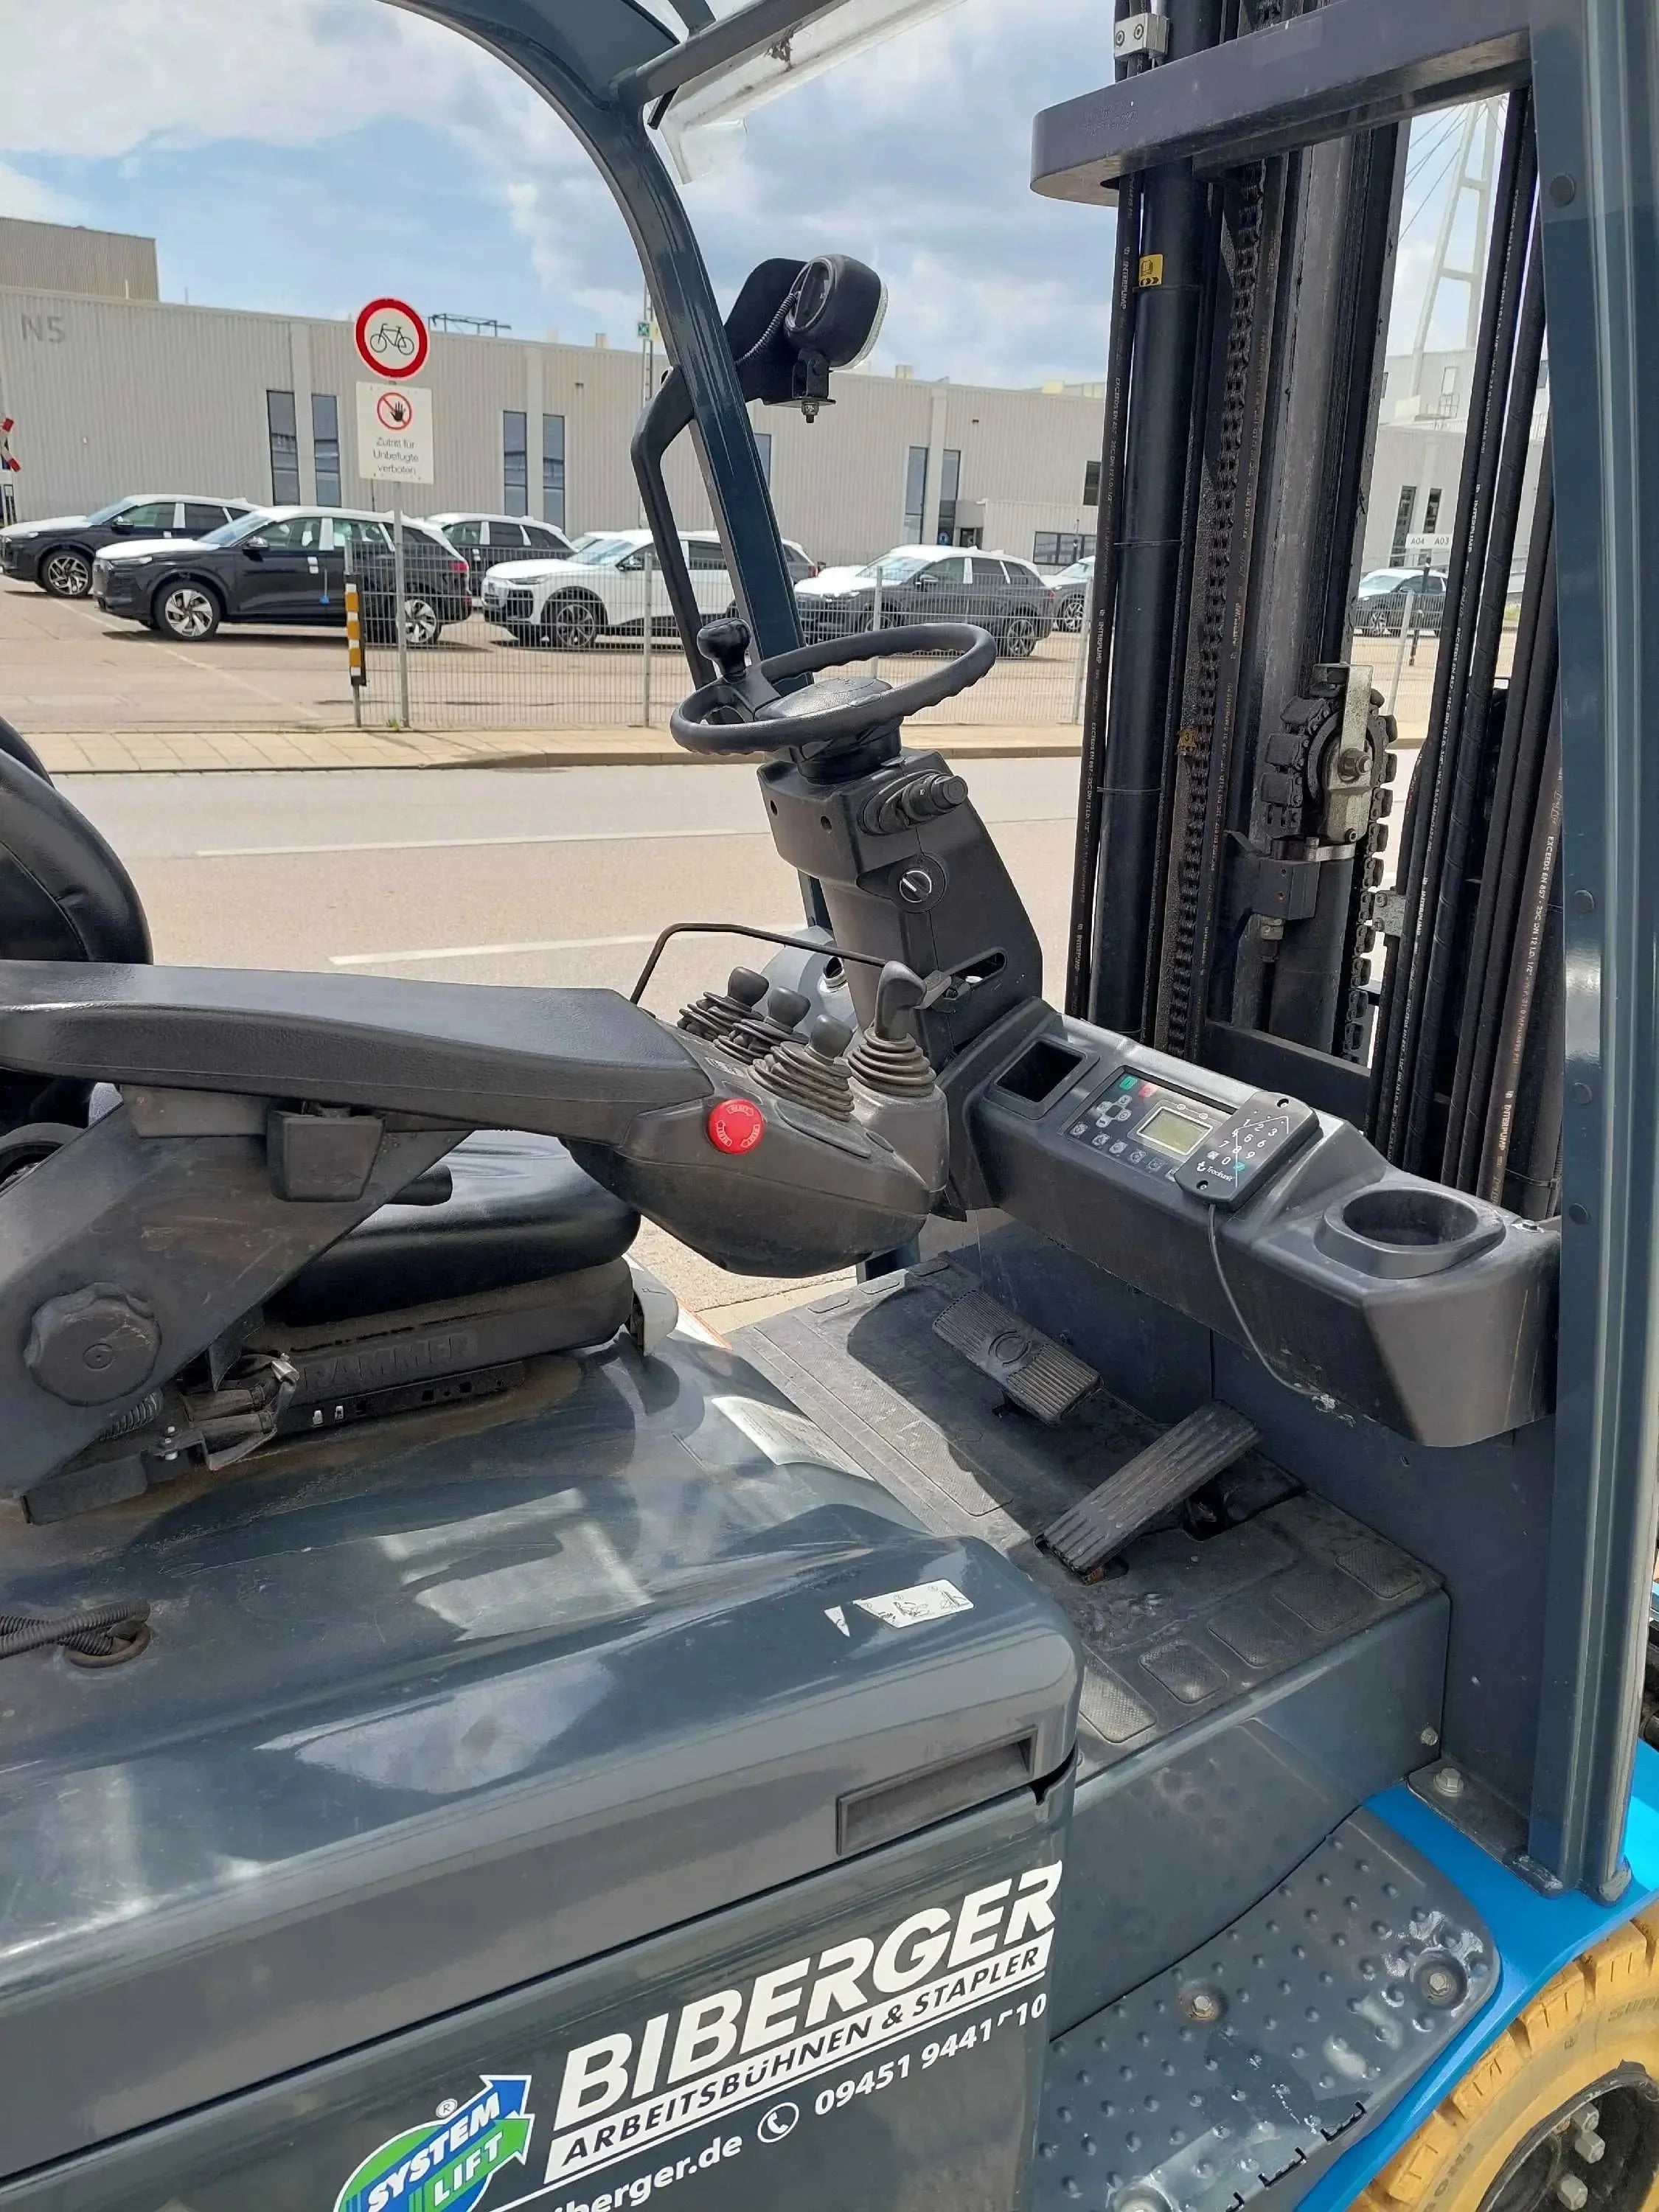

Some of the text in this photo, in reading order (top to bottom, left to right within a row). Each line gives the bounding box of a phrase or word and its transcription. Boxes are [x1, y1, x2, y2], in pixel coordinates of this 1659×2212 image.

[1118, 260, 1130, 310] INTERPUMP
[21, 313, 65, 344] N5
[1467, 499, 1478, 553] INTERPUMP
[1095, 621, 1105, 664] INTERPUMP
[1542, 835, 1554, 871] EXCEEDS
[1537, 884, 1547, 899] 857
[1539, 872, 1548, 883] EN
[1414, 890, 1427, 936] INTERPUMP
[1531, 922, 1541, 934] DN
[1533, 905, 1543, 921] 2SC
[1526, 946, 1537, 959] I.D.
[1529, 936, 1539, 945] 12
[1243, 1119, 1278, 1137] 1 2 3
[1244, 1133, 1254, 1143] 5
[1256, 1139, 1267, 1148] 6
[1498, 1104, 1512, 1151] INTERPUMP
[1219, 1140, 1231, 1148] 7
[1245, 1151, 1256, 1159] 9
[303, 1331, 474, 1392] RAMMER
[553, 1860, 1062, 2131] BIBERGER
[561, 1945, 1040, 2167] ARBEITSBÜHNEN & STAPLER
[814, 2054, 911, 2115] 09451
[368, 2092, 500, 2212] SYSTEM
[434, 2131, 504, 2207] LIFT
[554, 2135, 743, 2212] berger.de
